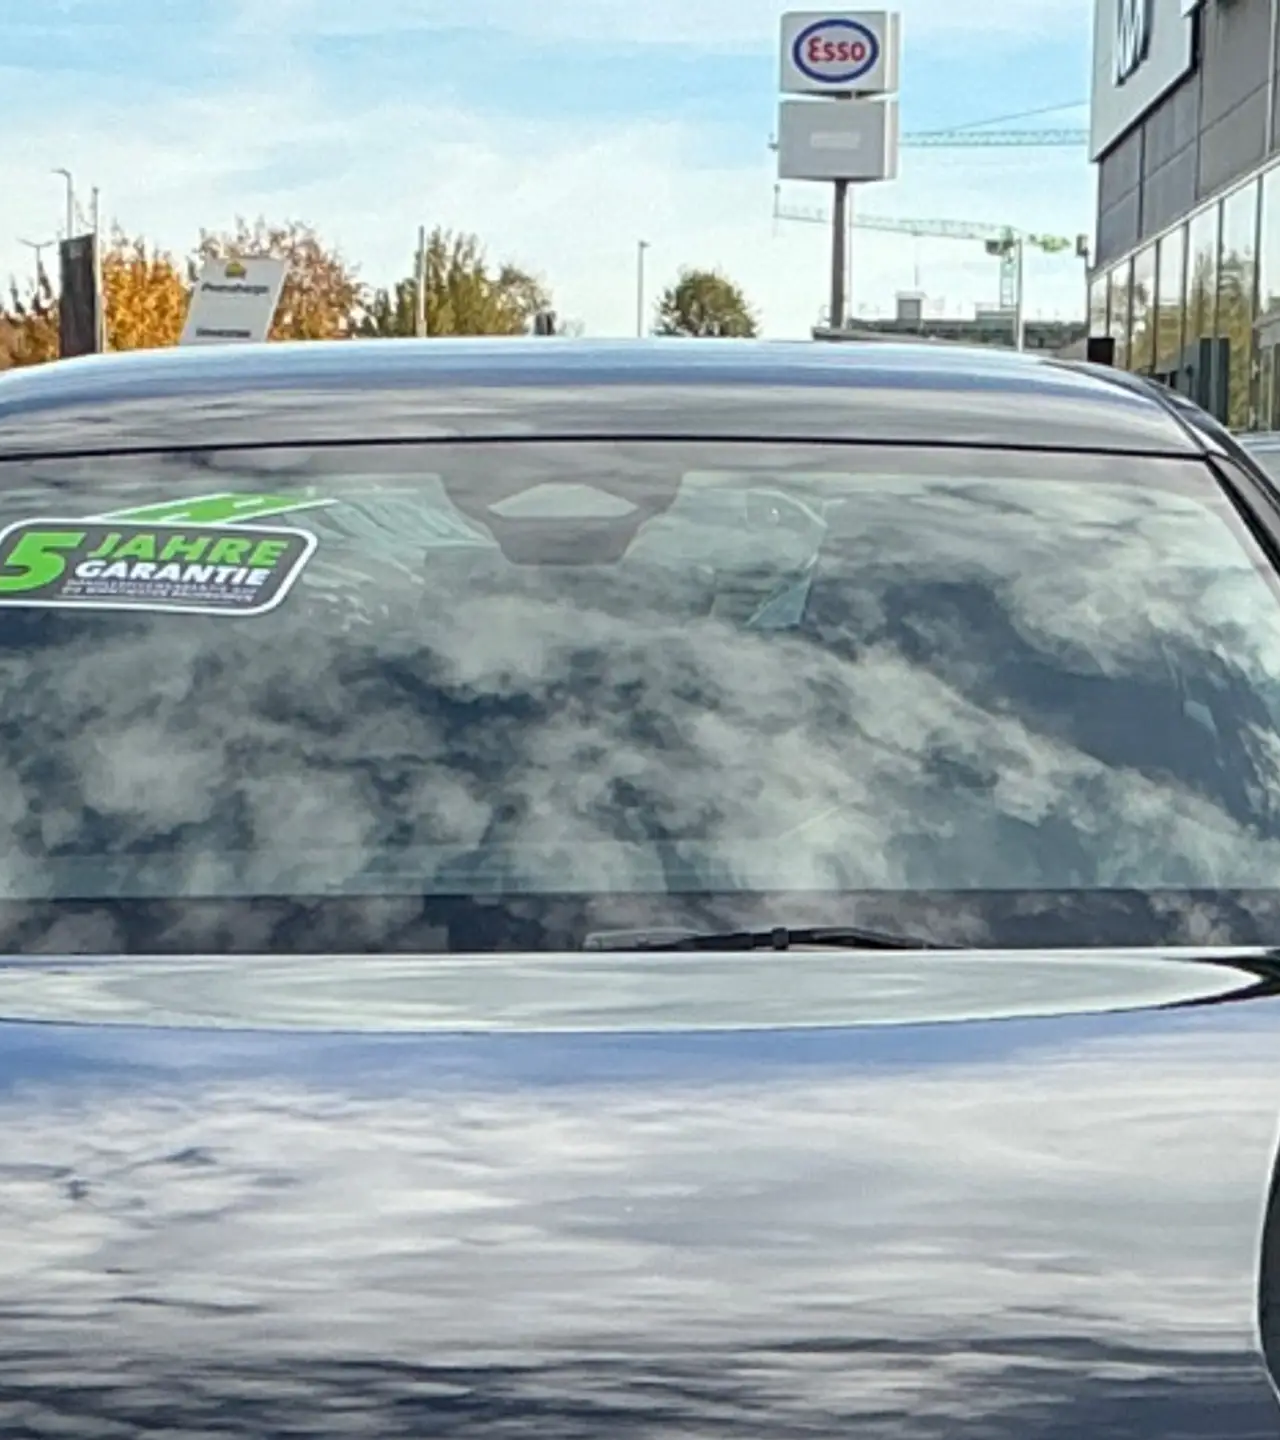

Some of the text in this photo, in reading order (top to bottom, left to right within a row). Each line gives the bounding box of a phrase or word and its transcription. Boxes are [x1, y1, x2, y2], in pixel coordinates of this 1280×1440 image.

[807, 36, 866, 62] Esso
[87, 533, 289, 567] JAHRE
[74, 560, 271, 586] GARANTIE
